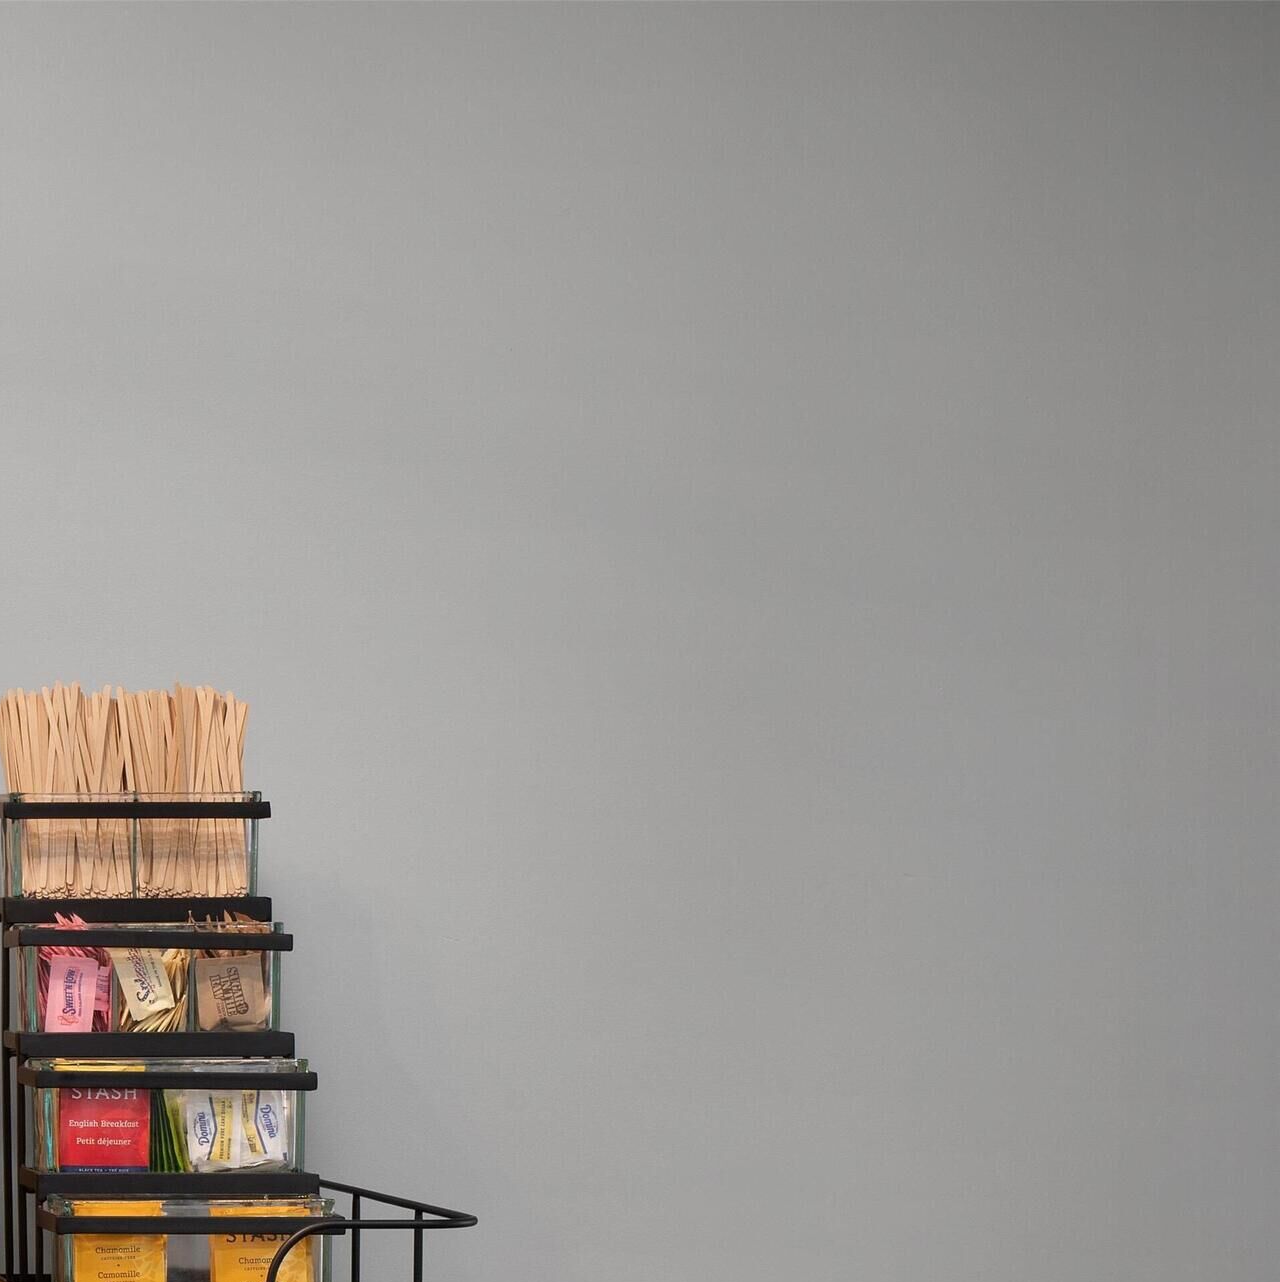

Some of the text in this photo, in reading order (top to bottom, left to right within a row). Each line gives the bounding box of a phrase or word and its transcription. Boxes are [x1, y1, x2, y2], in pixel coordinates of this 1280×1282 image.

[209, 974, 225, 1001] RAW
[68, 1119, 140, 1129] English Breakfast
[76, 1137, 132, 1147] Petit déjeuner
[95, 1245, 141, 1254] Chamomile
[238, 1257, 273, 1265] Chamom
[97, 1270, 141, 1279] Camomille
